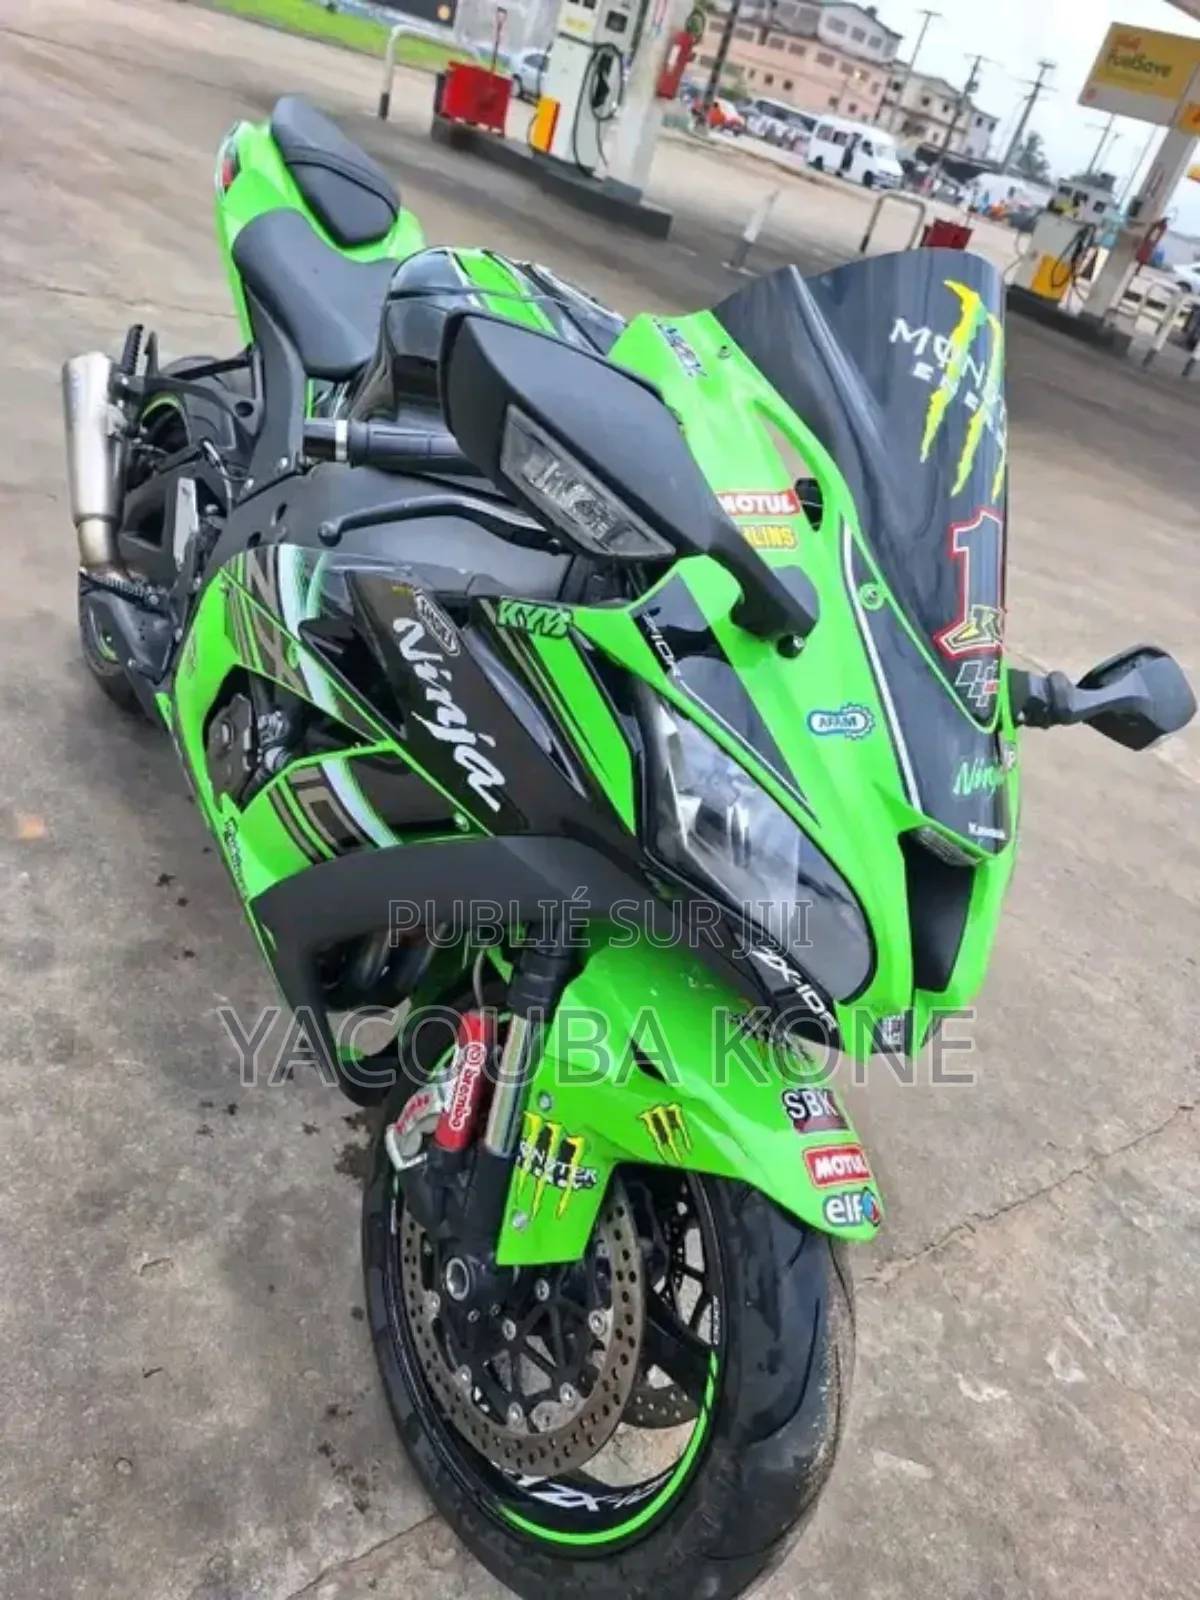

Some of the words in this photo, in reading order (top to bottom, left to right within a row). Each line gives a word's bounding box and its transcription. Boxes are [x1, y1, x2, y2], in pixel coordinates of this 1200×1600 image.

[393, 617, 505, 813] Ninja
[783, 1089, 839, 1120] SBK
[825, 1193, 864, 1225] elf
